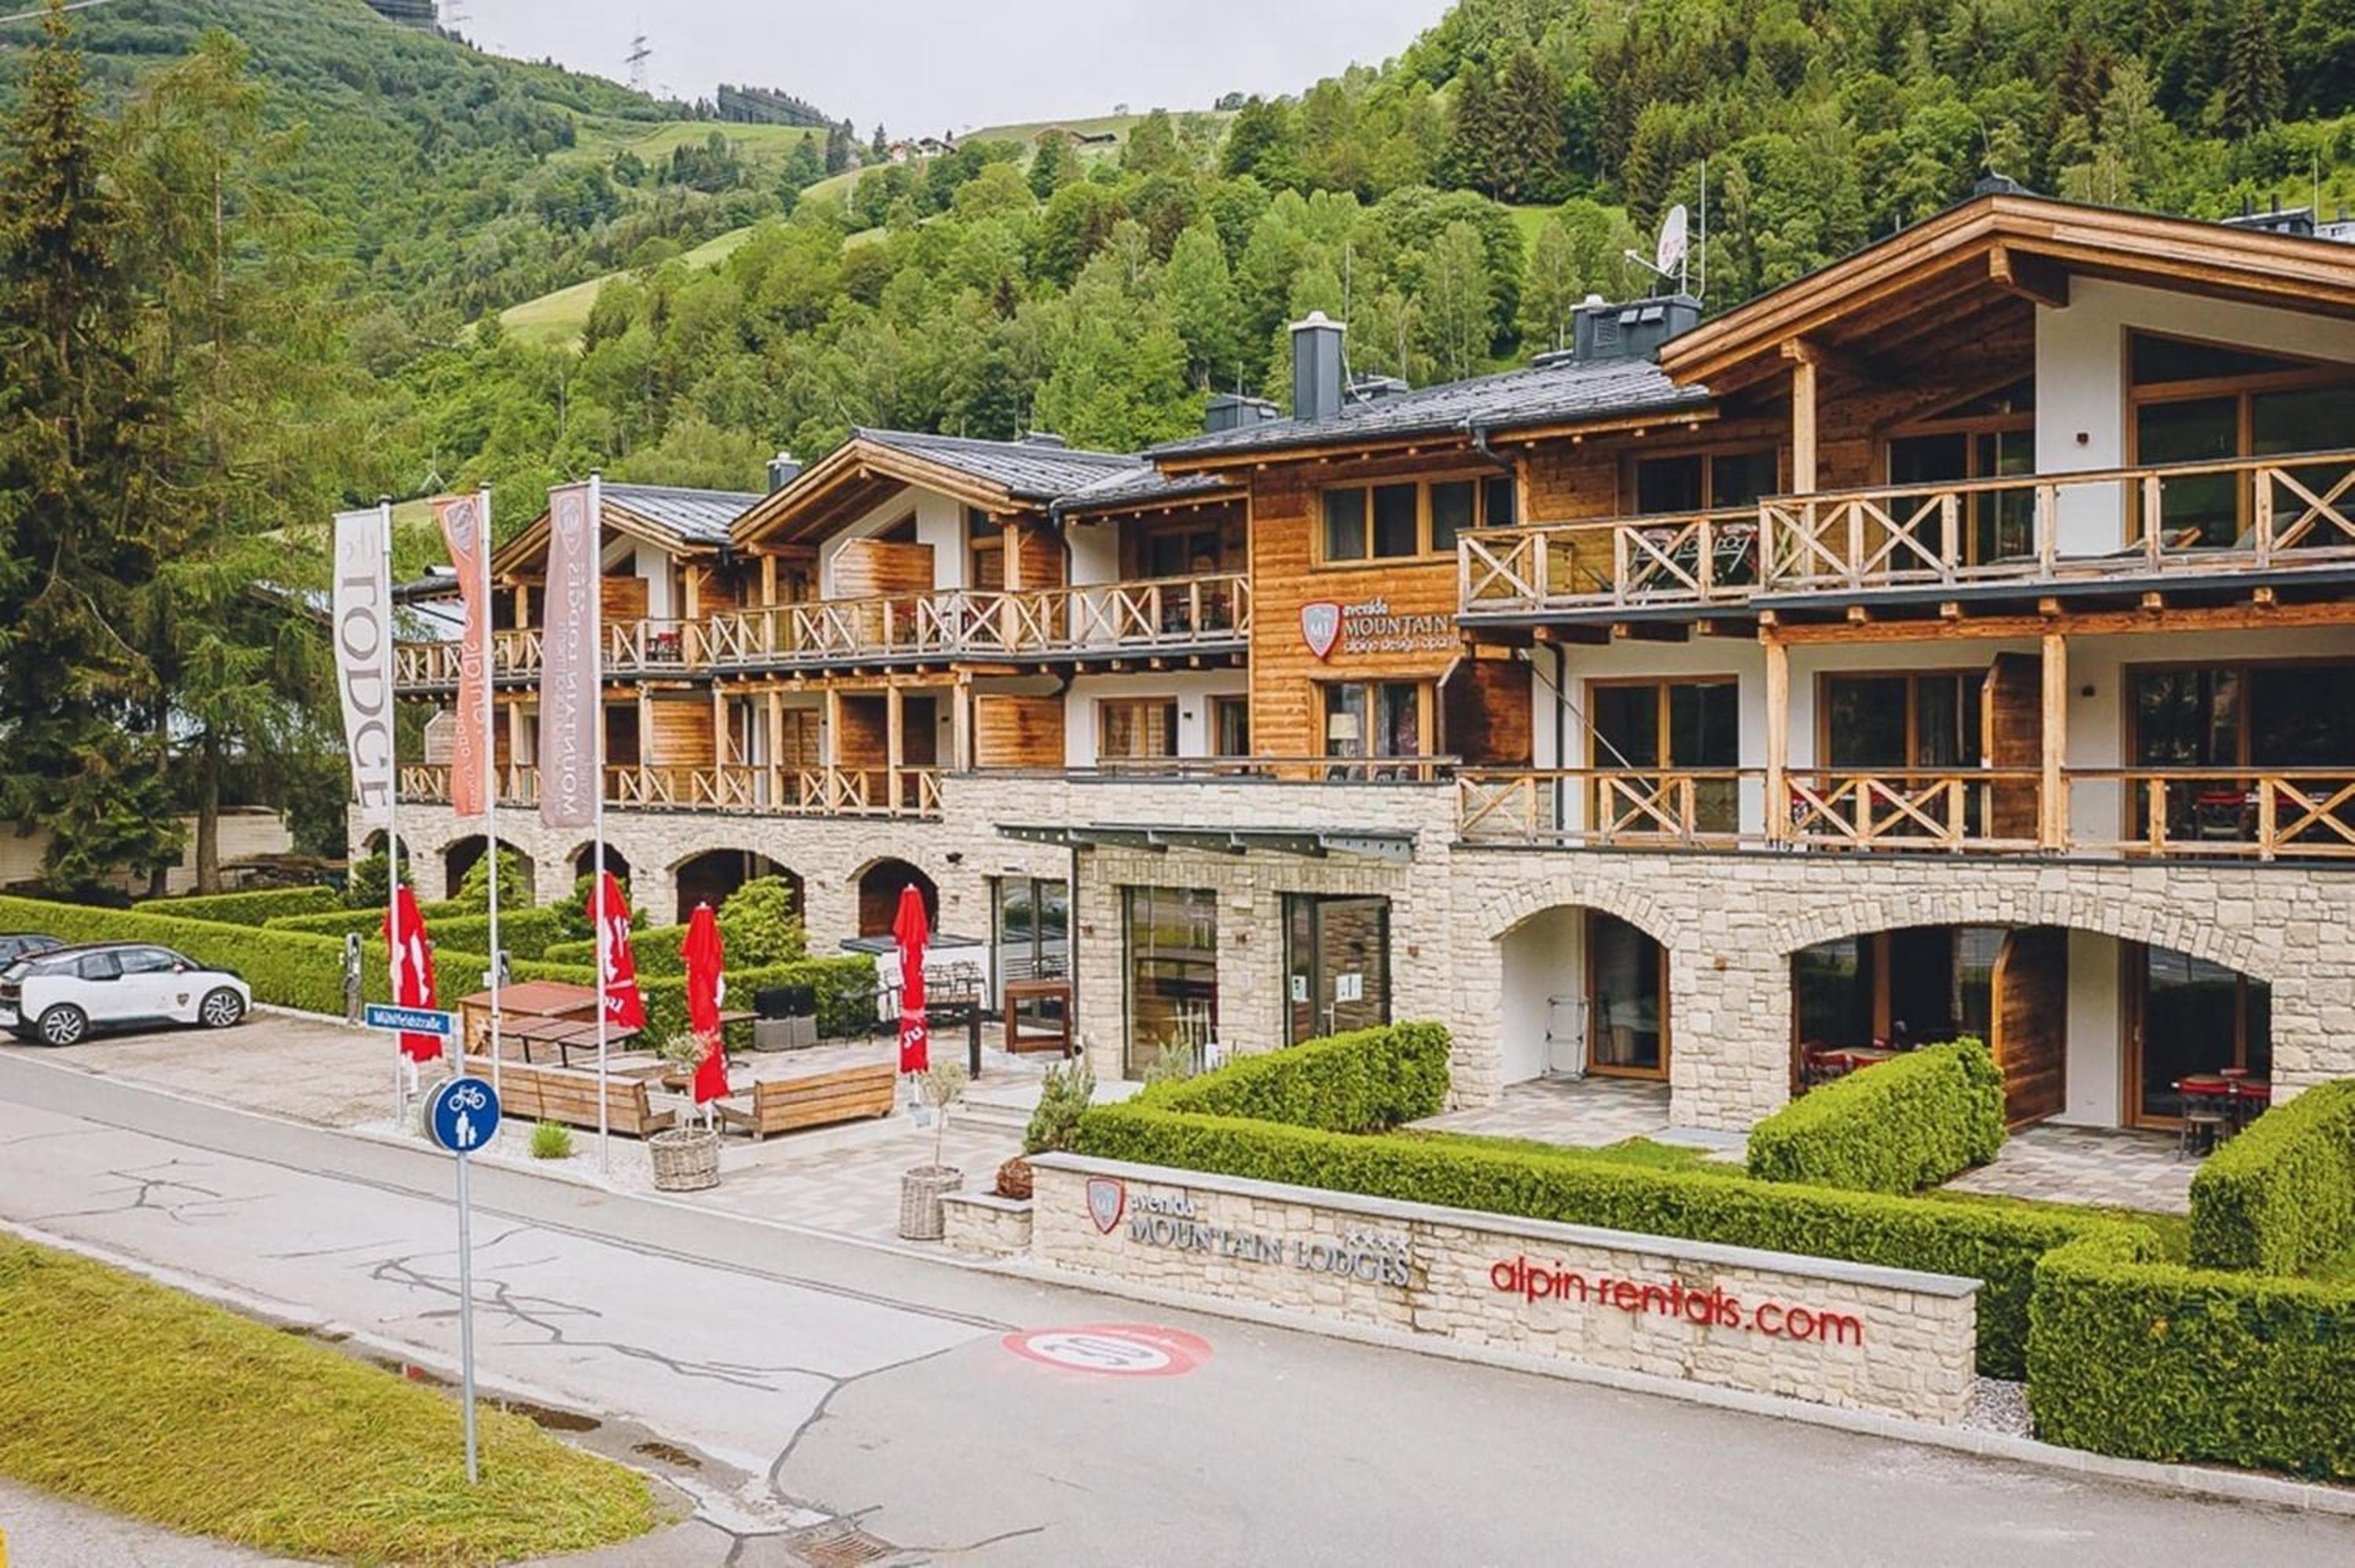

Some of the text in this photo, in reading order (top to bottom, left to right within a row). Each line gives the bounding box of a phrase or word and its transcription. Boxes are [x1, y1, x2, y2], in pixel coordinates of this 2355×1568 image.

[1343, 614, 1448, 638] MOUNTAIN
[1130, 1193, 1195, 1218] avenida
[1130, 1216, 1411, 1287] MOUNTAIN LODGES
